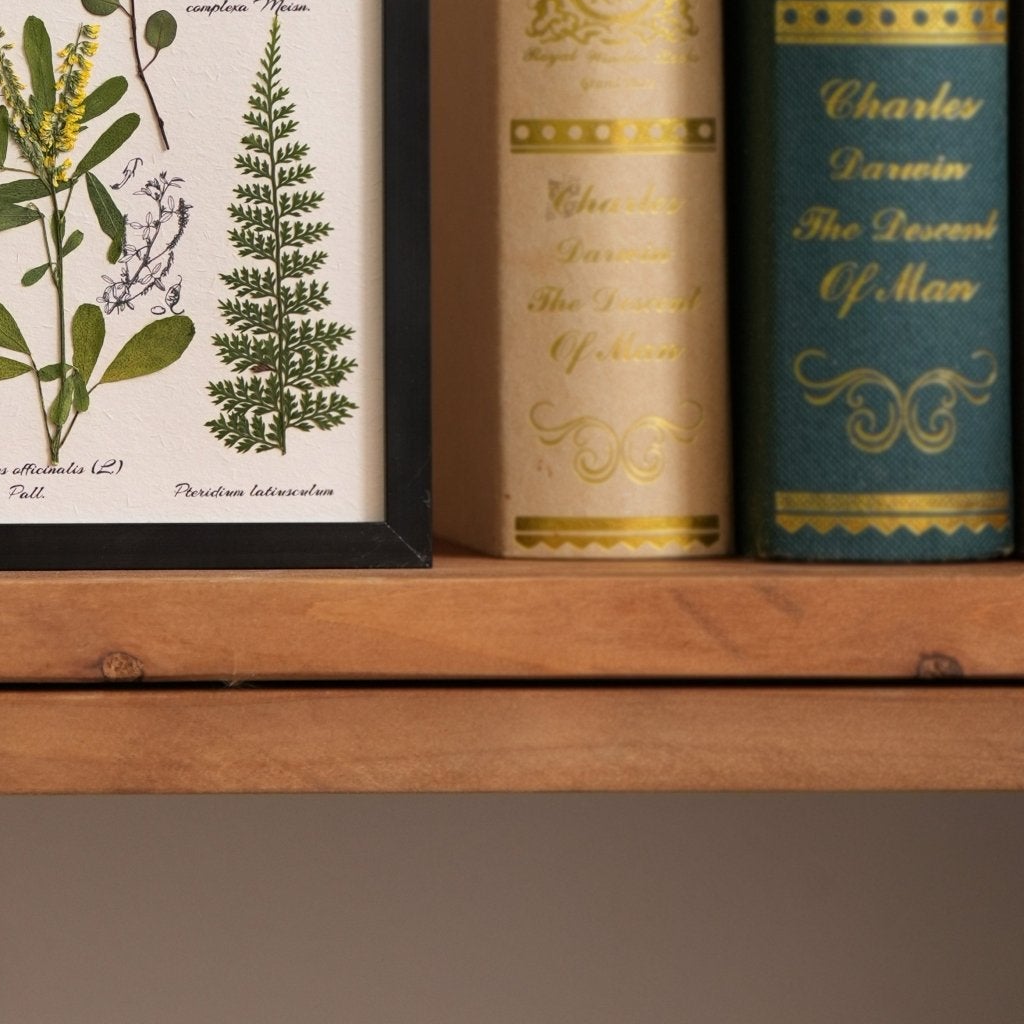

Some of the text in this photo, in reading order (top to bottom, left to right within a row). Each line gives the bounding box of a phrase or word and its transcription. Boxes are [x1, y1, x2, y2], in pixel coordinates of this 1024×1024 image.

[185, 0, 249, 17] complexa
[820, 79, 984, 120] Charles
[830, 146, 972, 181] Darwin
[545, 180, 685, 216] Charles
[792, 206, 999, 242] The Descent
[555, 237, 673, 265] Darwin
[528, 285, 581, 312] The
[819, 261, 981, 320] Of Man
[548, 329, 685, 375] Of Man
[12, 462, 85, 476] officinalis
[9, 484, 45, 499] Pall.
[174, 483, 334, 498] Pteridium latiusculum
